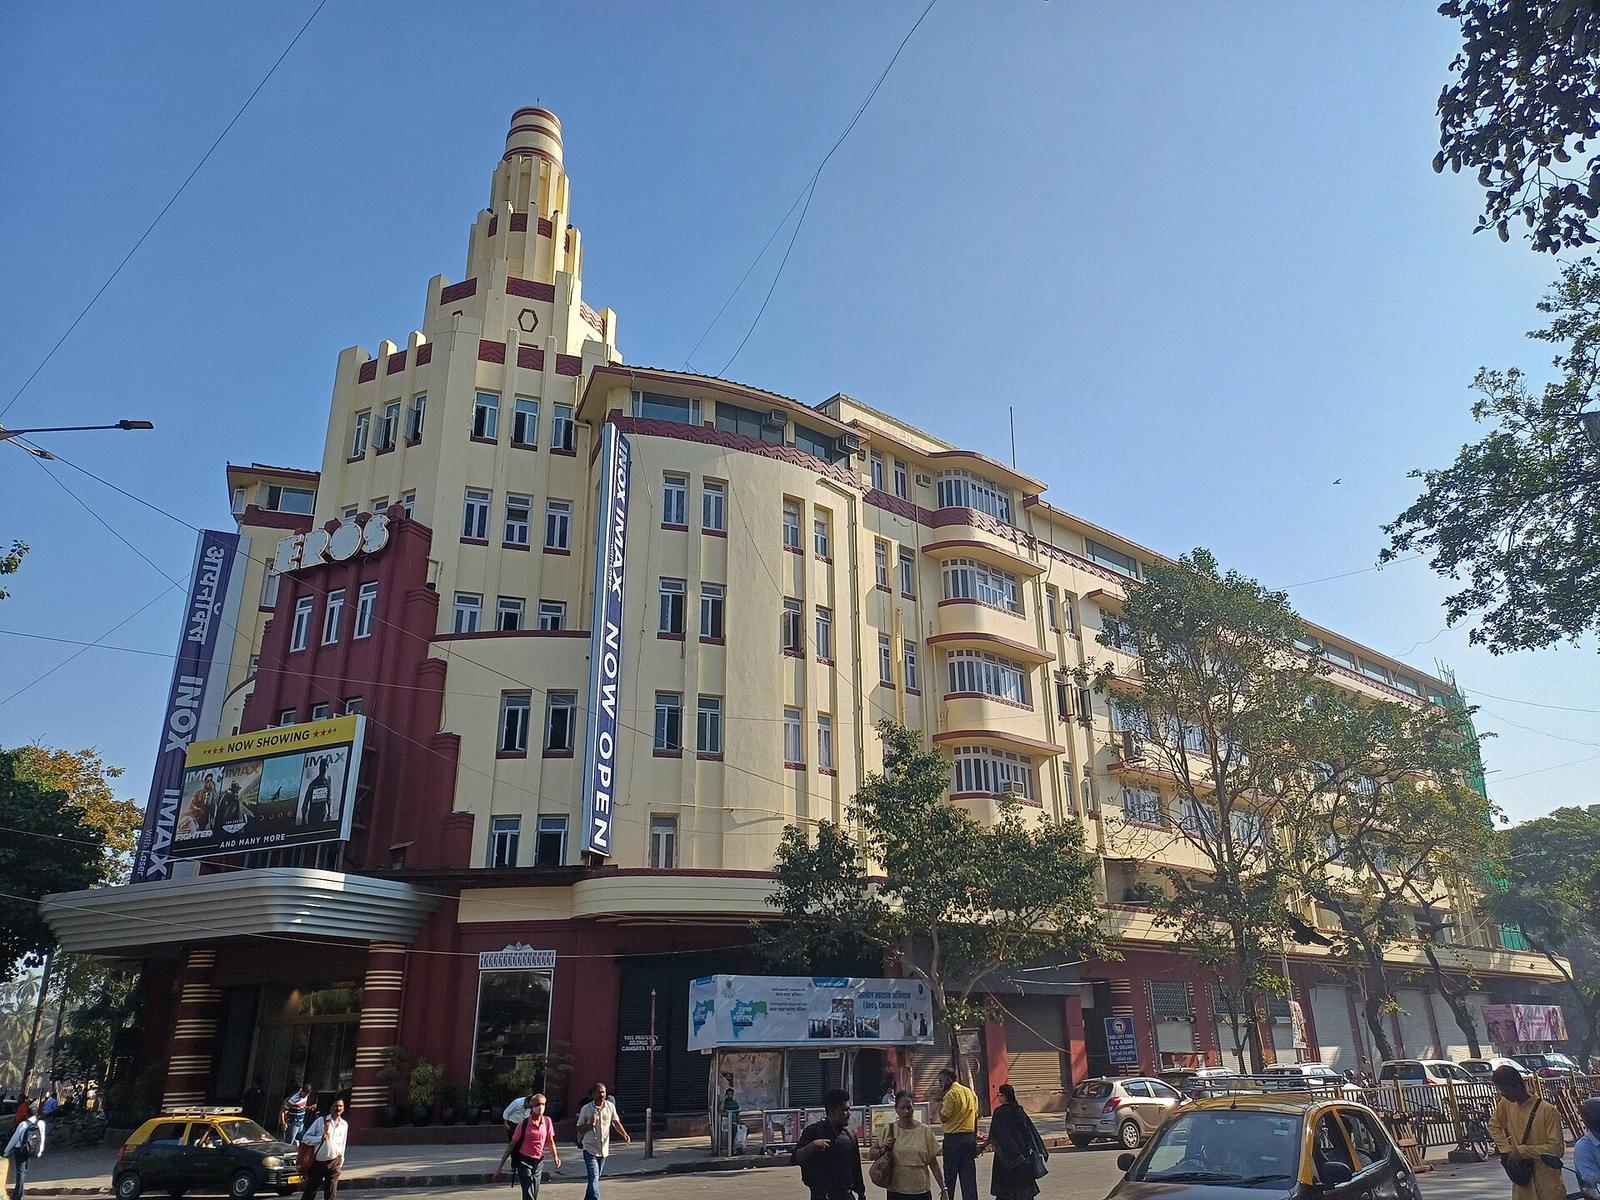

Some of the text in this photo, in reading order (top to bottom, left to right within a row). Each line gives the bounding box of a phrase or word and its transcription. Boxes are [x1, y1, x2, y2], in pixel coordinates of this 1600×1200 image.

[272, 514, 390, 575] EROS
[593, 440, 628, 848] INOX IMAX NOW OPEN
[146, 545, 225, 877] आयनॉक्स INOX IMAX
[227, 730, 310, 753] NOW SHOWING
[225, 764, 260, 778] IMAX
[305, 751, 345, 769] IMAX
[174, 830, 214, 842] FIGHTER
[219, 833, 286, 849] AND MANY MORE
[137, 828, 153, 877] with Laser
